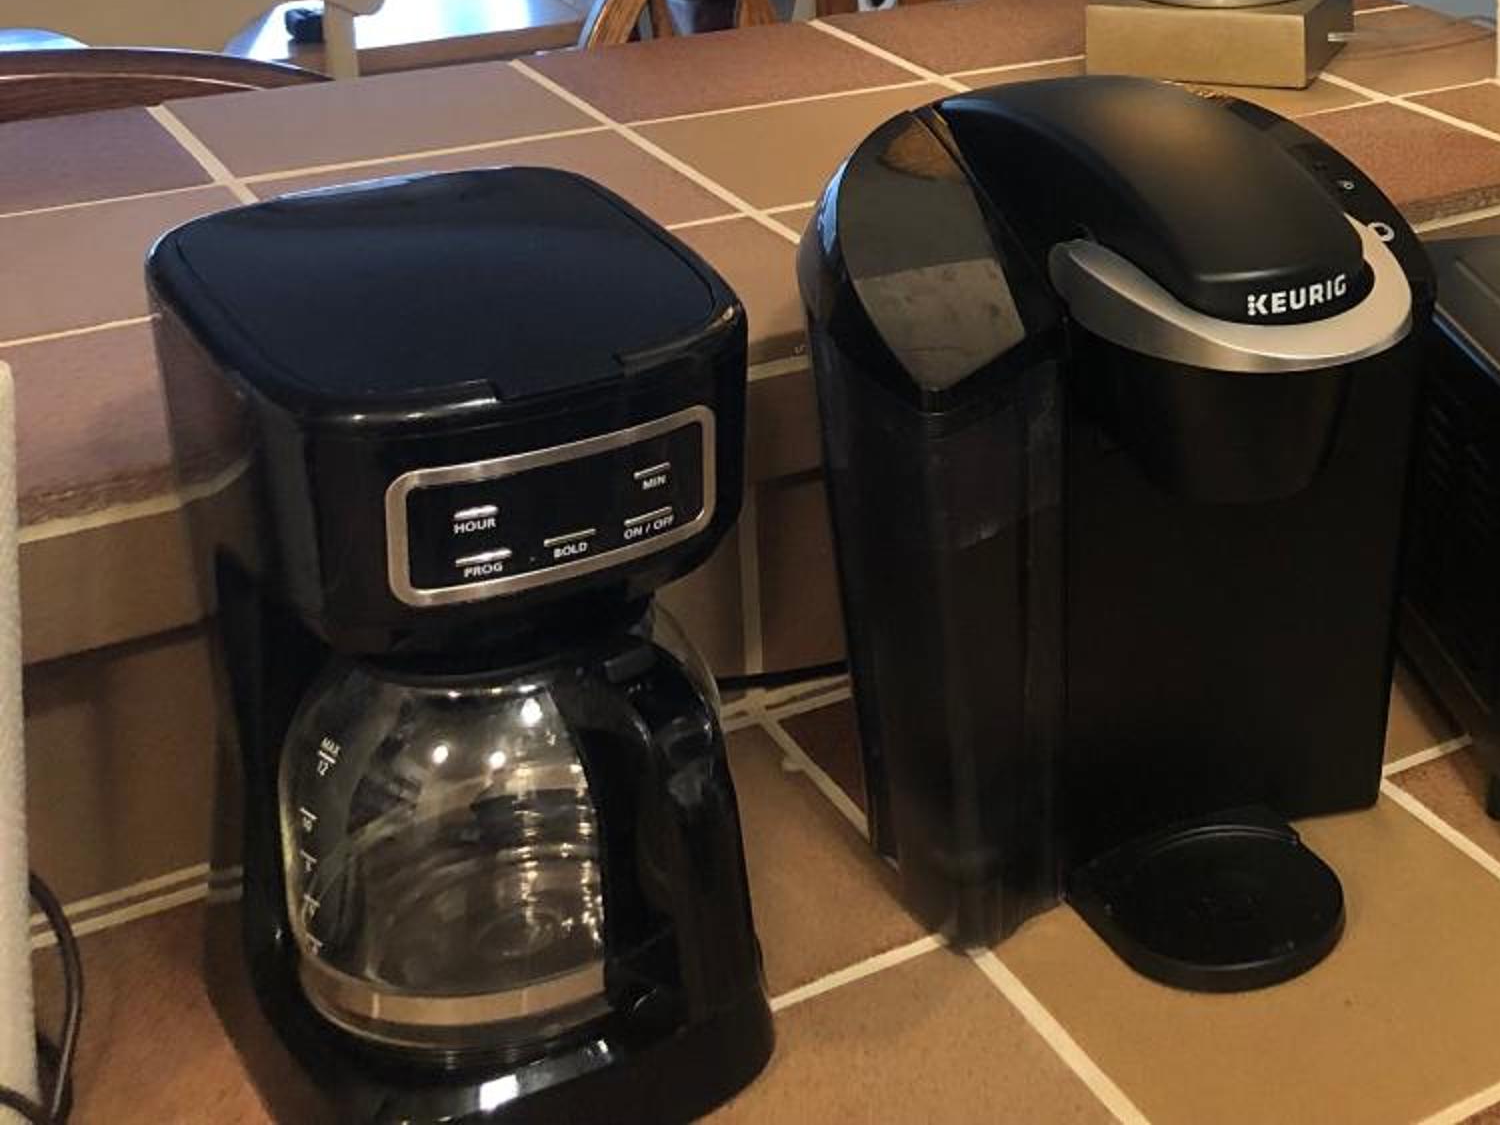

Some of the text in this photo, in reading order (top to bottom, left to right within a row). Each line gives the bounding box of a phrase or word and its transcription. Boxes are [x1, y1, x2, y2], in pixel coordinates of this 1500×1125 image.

[1247, 274, 1347, 316] KEURIG
[642, 475, 667, 490] MIN
[453, 517, 497, 534] HOUR
[623, 526, 643, 540] ON
[653, 515, 674, 530] OFF
[553, 542, 588, 559] BOLD
[463, 562, 503, 578] PROG
